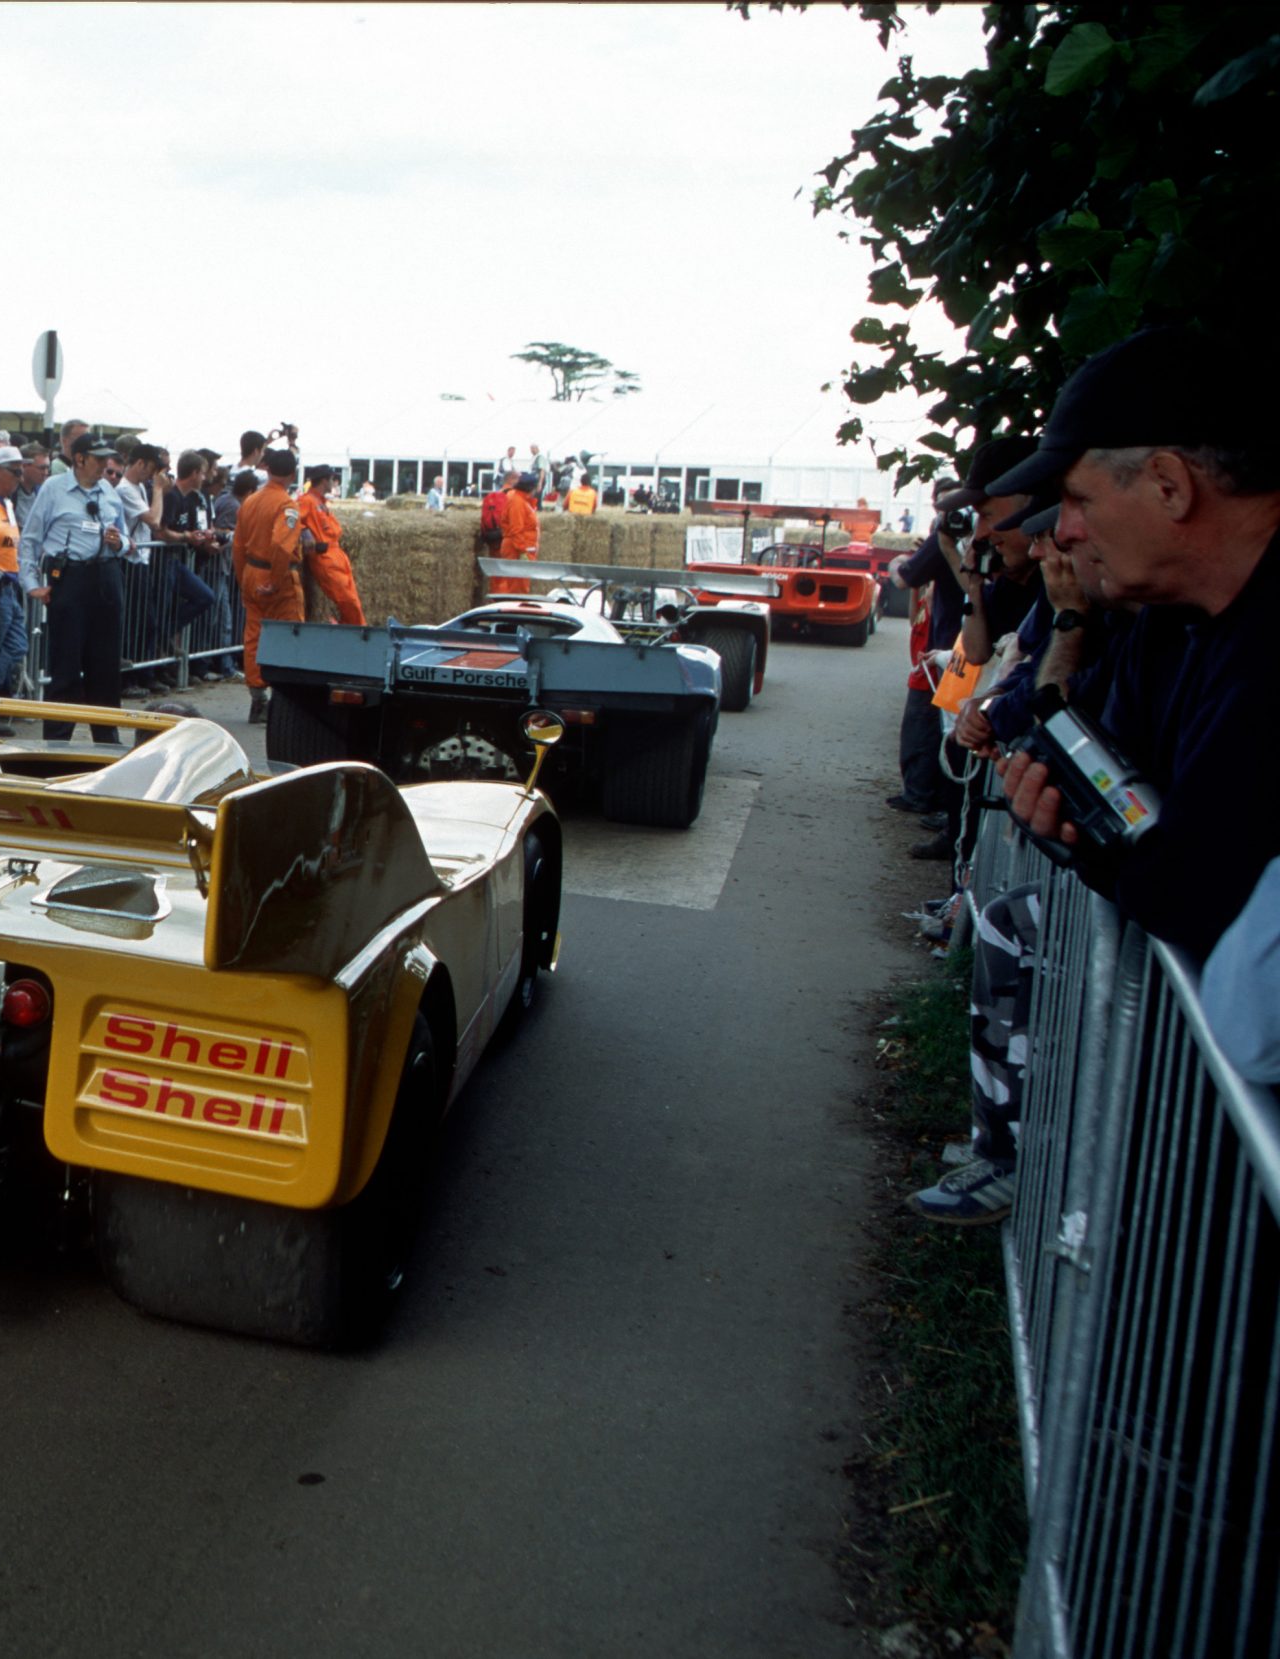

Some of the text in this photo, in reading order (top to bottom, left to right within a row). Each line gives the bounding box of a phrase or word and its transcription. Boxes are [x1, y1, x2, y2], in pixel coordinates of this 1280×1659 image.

[401, 665, 437, 681] Gulf
[452, 669, 528, 688] Porsche
[103, 1013, 292, 1079] Shell
[99, 1067, 287, 1135] Shell
